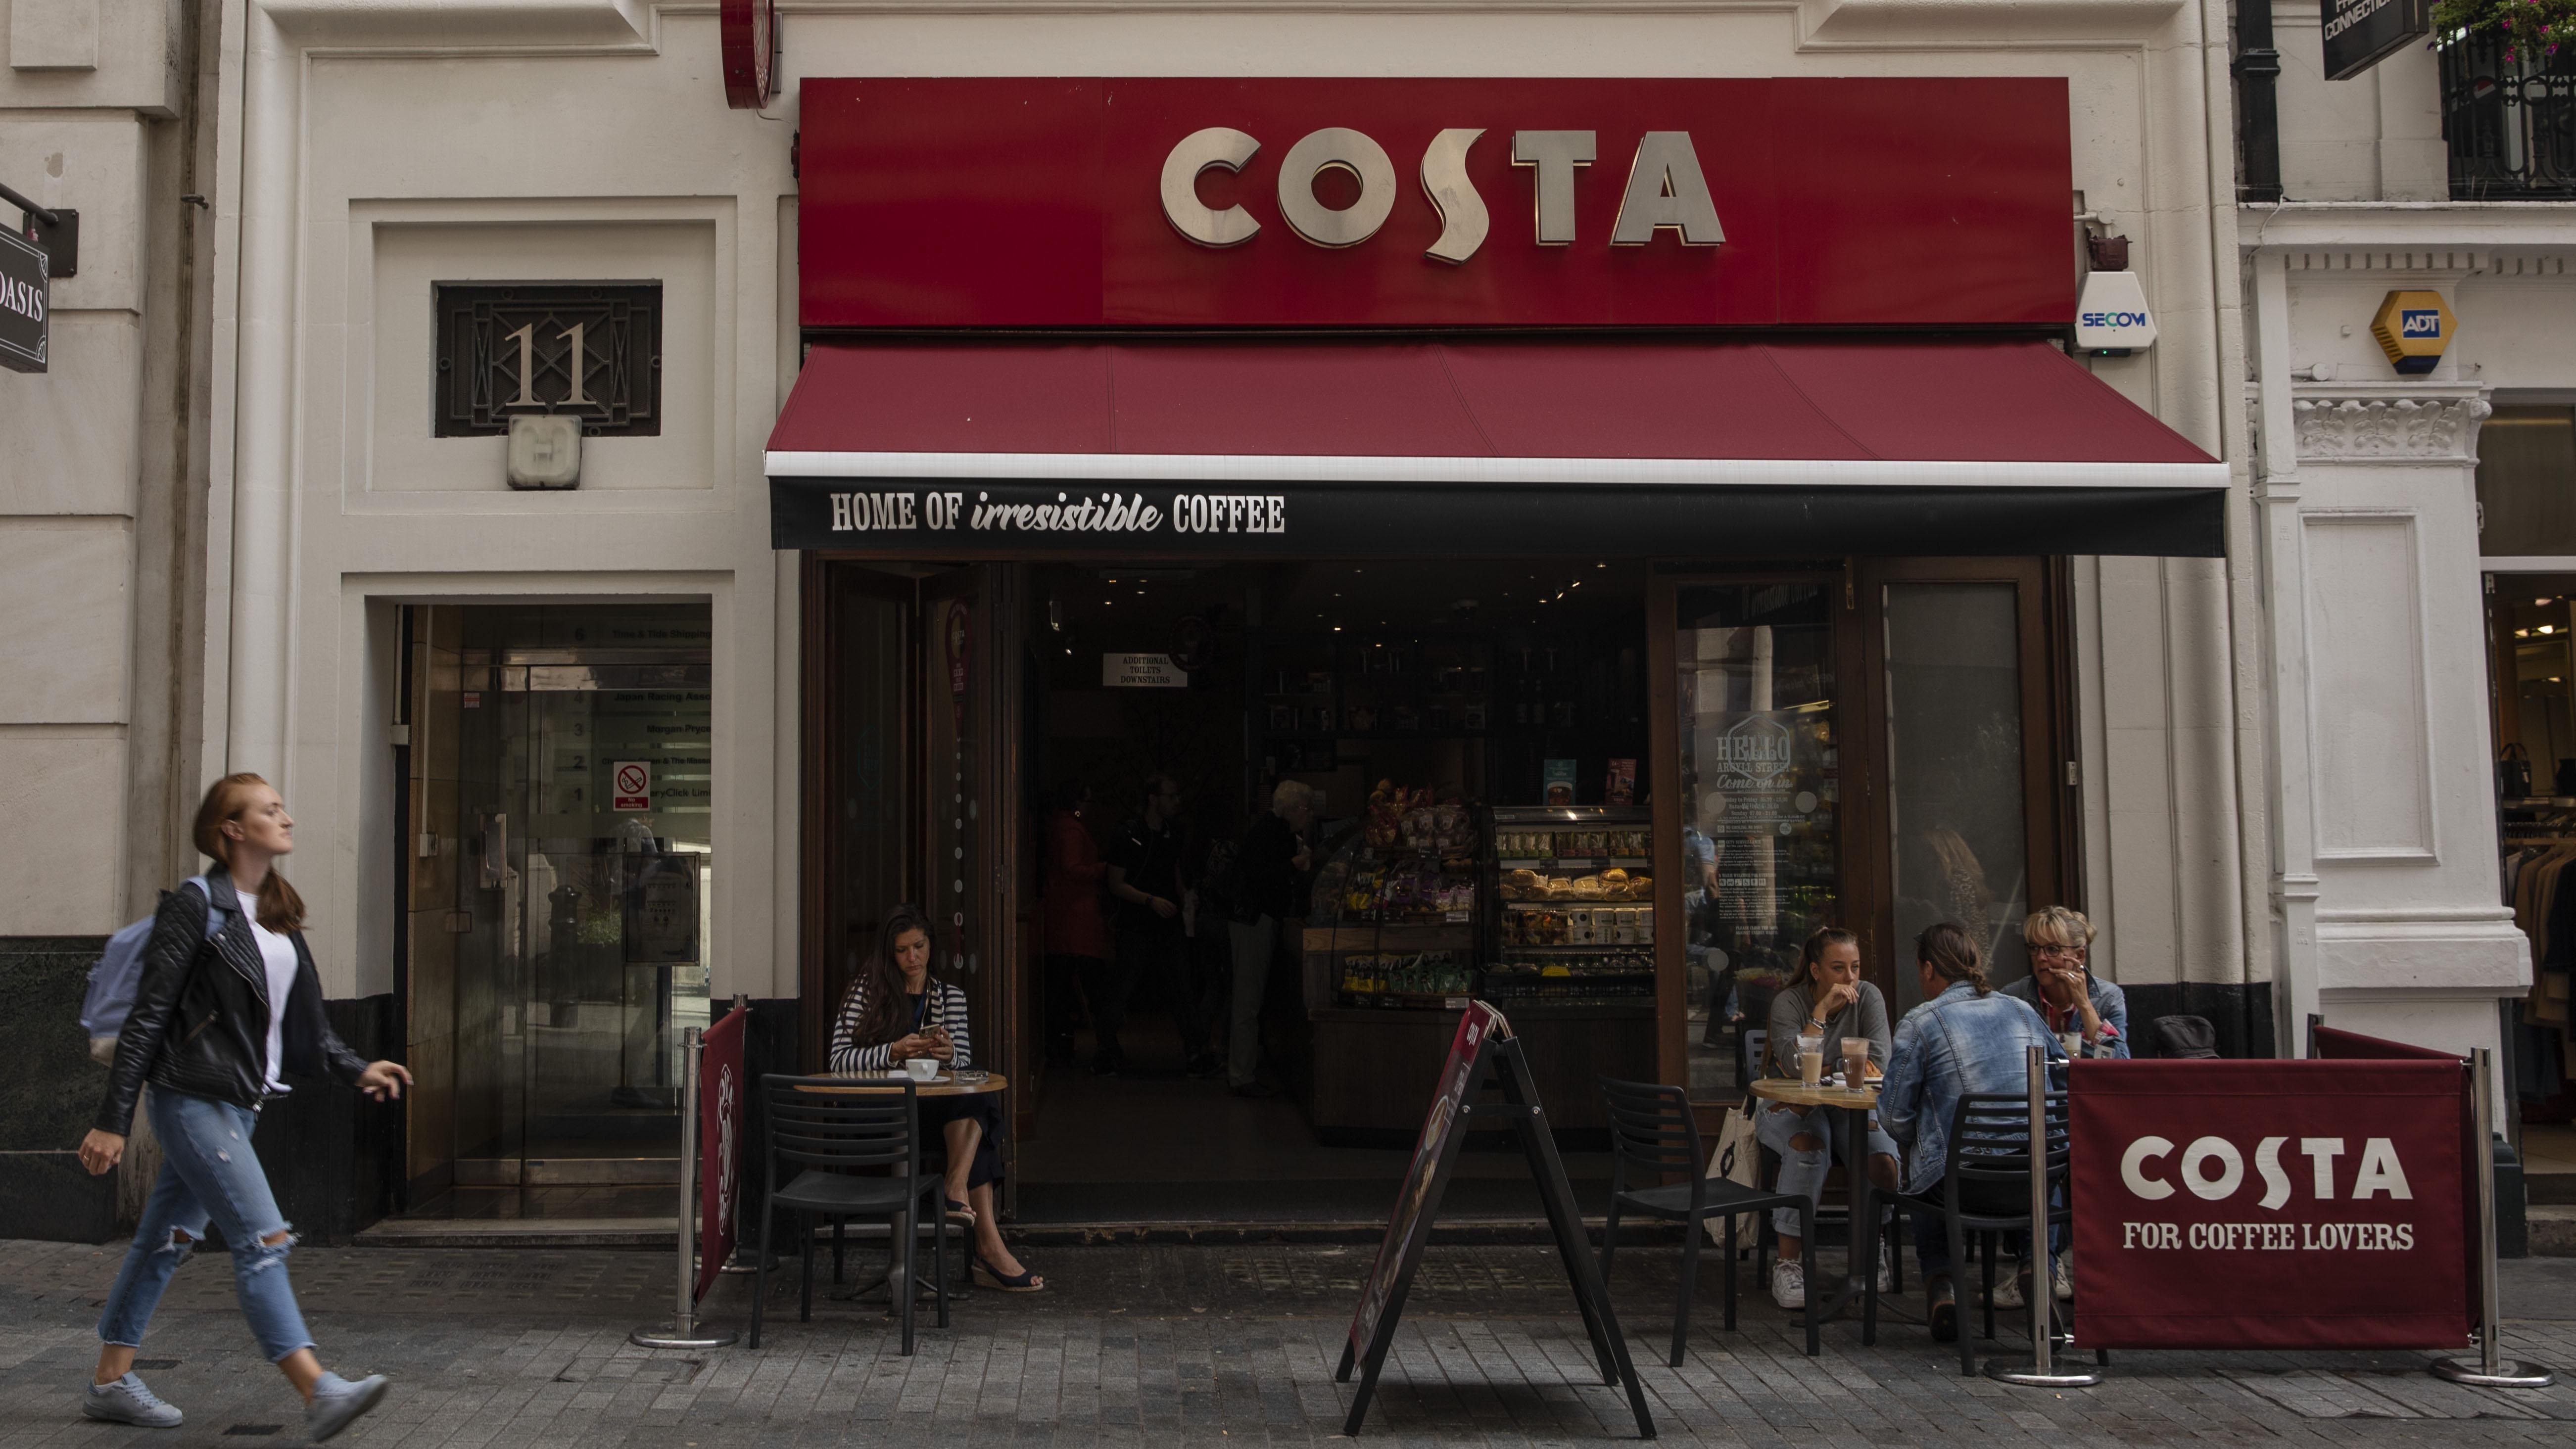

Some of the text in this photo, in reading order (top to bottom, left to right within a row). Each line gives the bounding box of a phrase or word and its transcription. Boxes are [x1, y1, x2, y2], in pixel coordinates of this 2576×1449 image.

[1160, 127, 1726, 264] COSTA
[2082, 312, 2146, 327] SECOM
[2402, 315, 2439, 333] ADT
[505, 322, 597, 406] 11
[830, 491, 1285, 534] HOME OF irresistible COFFEE
[669, 630, 711, 640] Shipping
[614, 693, 644, 702] Japan
[648, 693, 681, 702] Racing
[574, 723, 583, 736] 3
[647, 725, 681, 734] Morgan
[1716, 737, 1790, 760] HELLO
[1717, 774, 1754, 789] Come
[1756, 778, 1774, 789] on
[2120, 1136, 2413, 1211] COSTA
[2123, 1222, 2414, 1250] FOR COFFEE LOVERS
